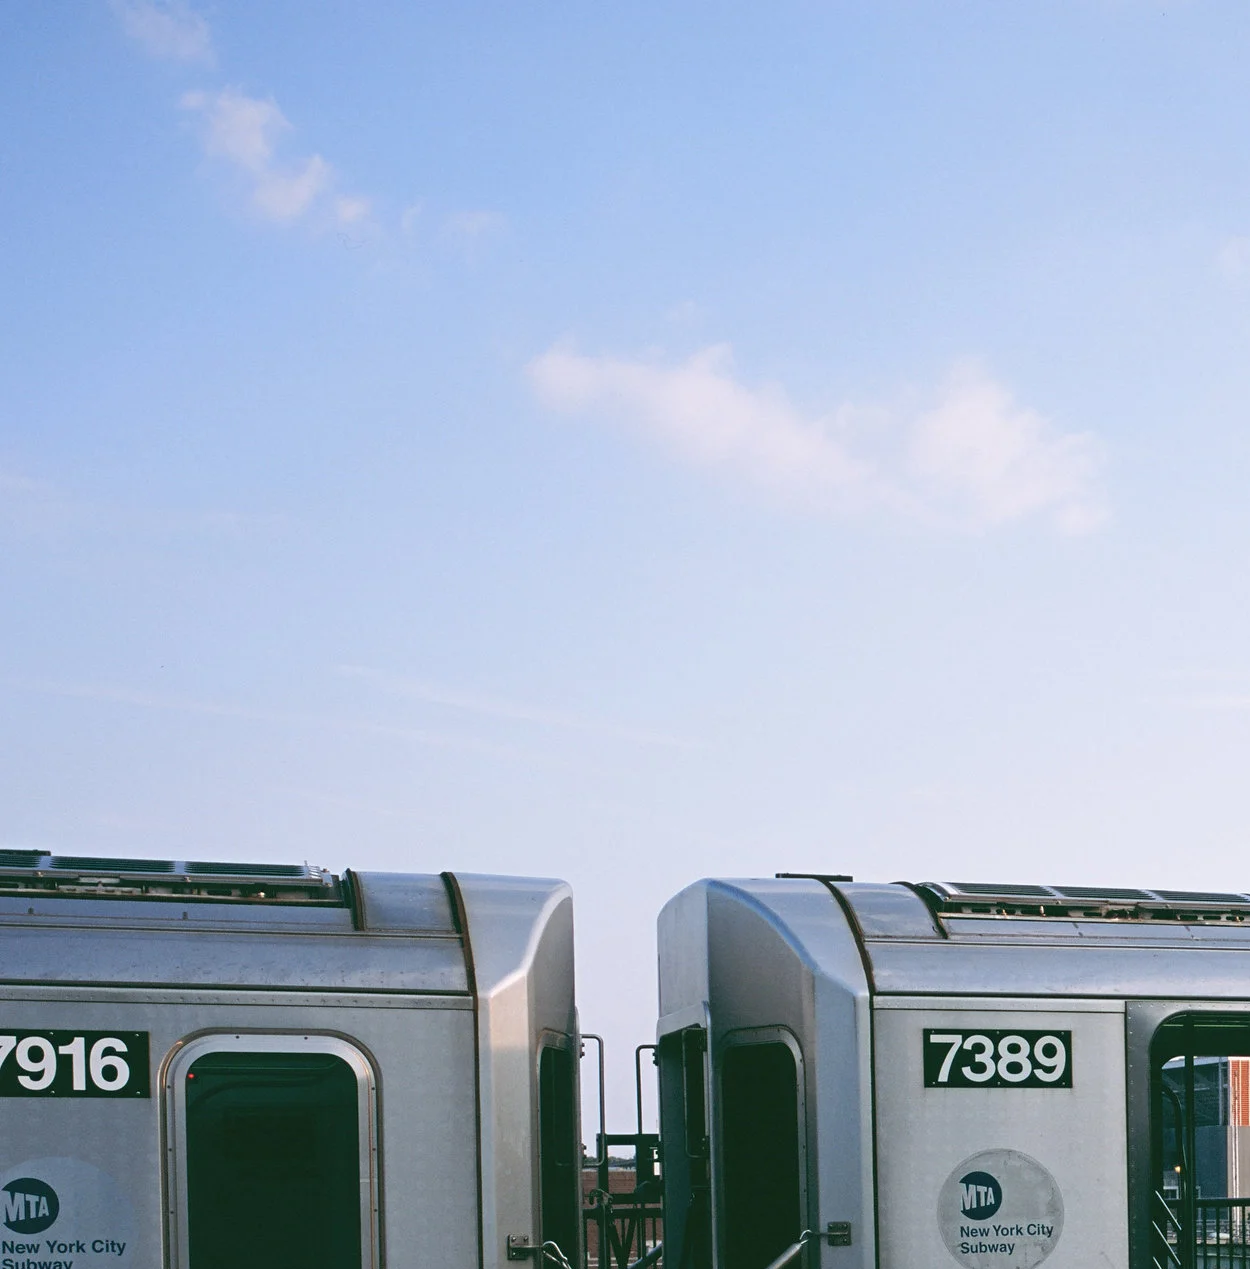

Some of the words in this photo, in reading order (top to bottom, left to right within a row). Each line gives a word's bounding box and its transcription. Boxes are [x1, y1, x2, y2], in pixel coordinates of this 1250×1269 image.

[929, 1034, 1067, 1083] 7389
[1, 1189, 50, 1223] MTA
[960, 1182, 995, 1211] MTA
[960, 1225, 990, 1238] New
[992, 1223, 1024, 1237] York
[1026, 1222, 1054, 1239] City
[1, 1240, 41, 1255] New
[46, 1240, 87, 1254] York
[91, 1239, 127, 1257] City
[960, 1241, 1016, 1256] Subway
